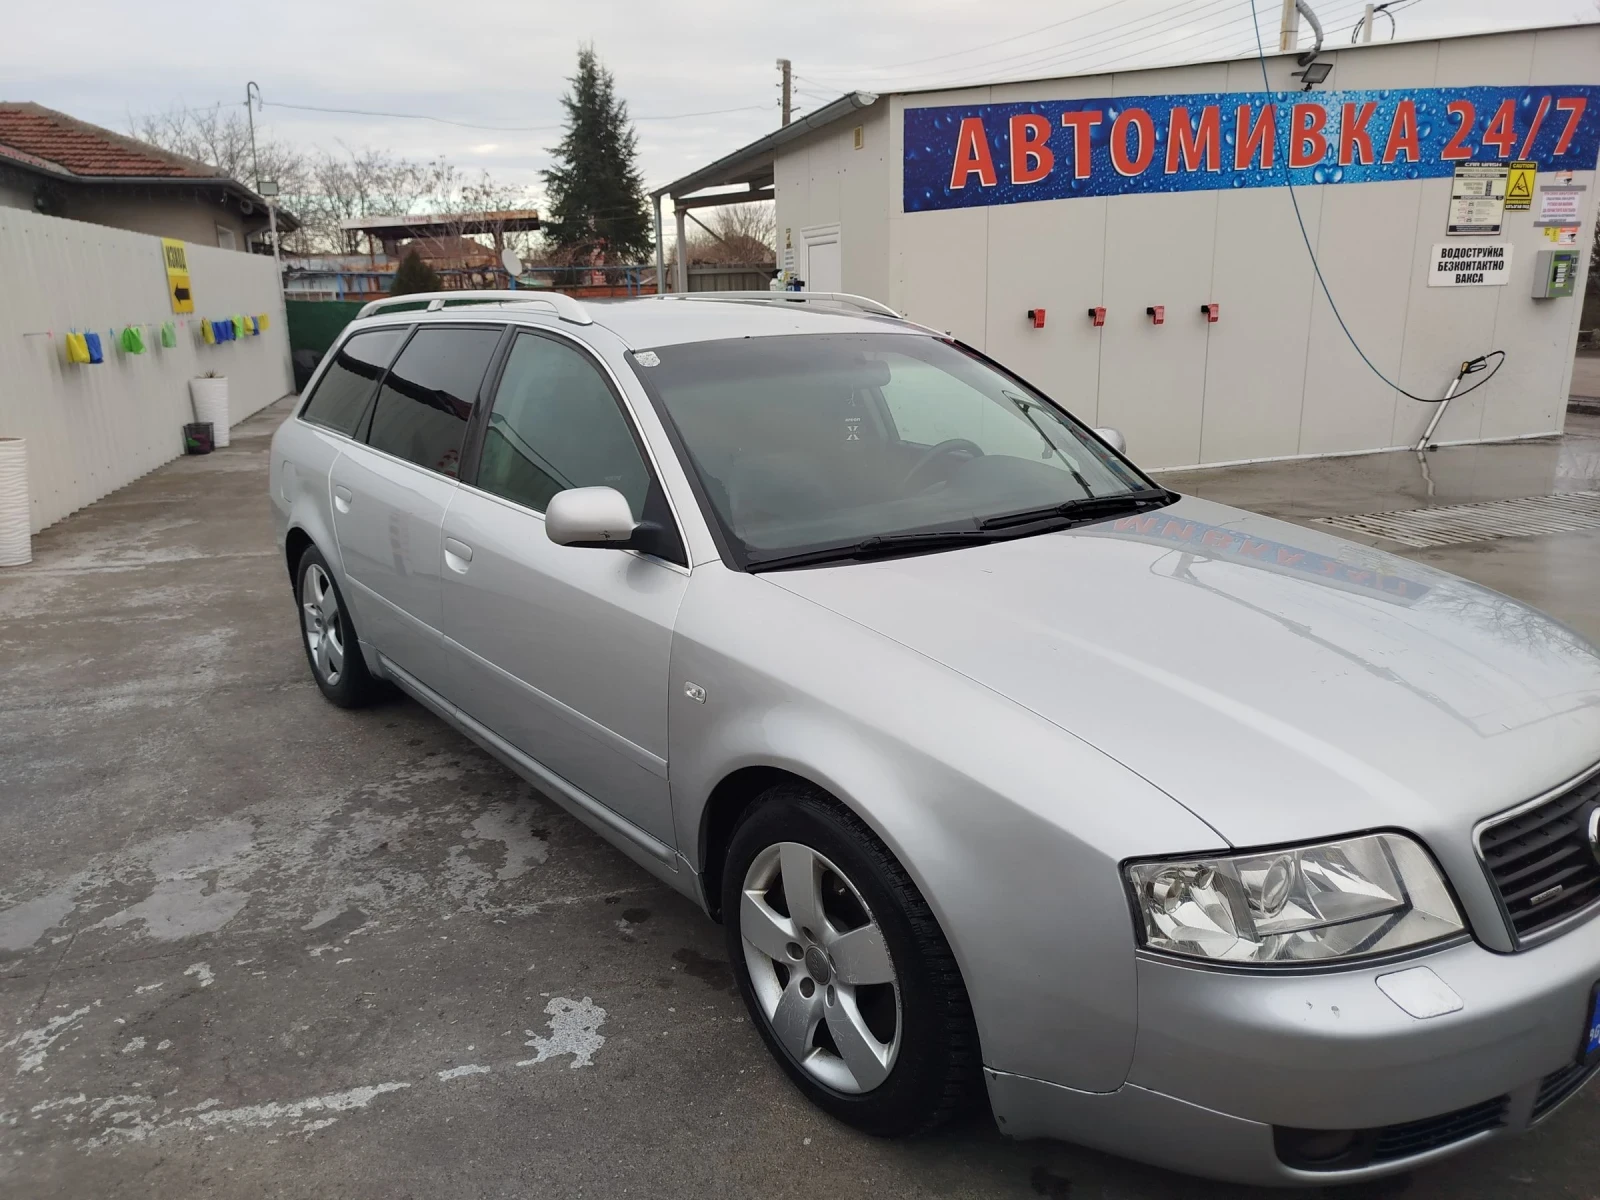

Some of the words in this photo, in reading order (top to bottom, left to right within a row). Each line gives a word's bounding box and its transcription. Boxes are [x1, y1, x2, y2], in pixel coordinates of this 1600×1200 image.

[950, 100, 1420, 190] АВТОМИВКА
[1440, 95, 1588, 160] 24/7
[166, 246, 188, 273] ИЗХОД
[1441, 246, 1504, 260] ВОДОСТРУЙКА
[1437, 261, 1504, 272] БЕЗКОНТАКТНО
[1455, 273, 1484, 284] ВАКСА
